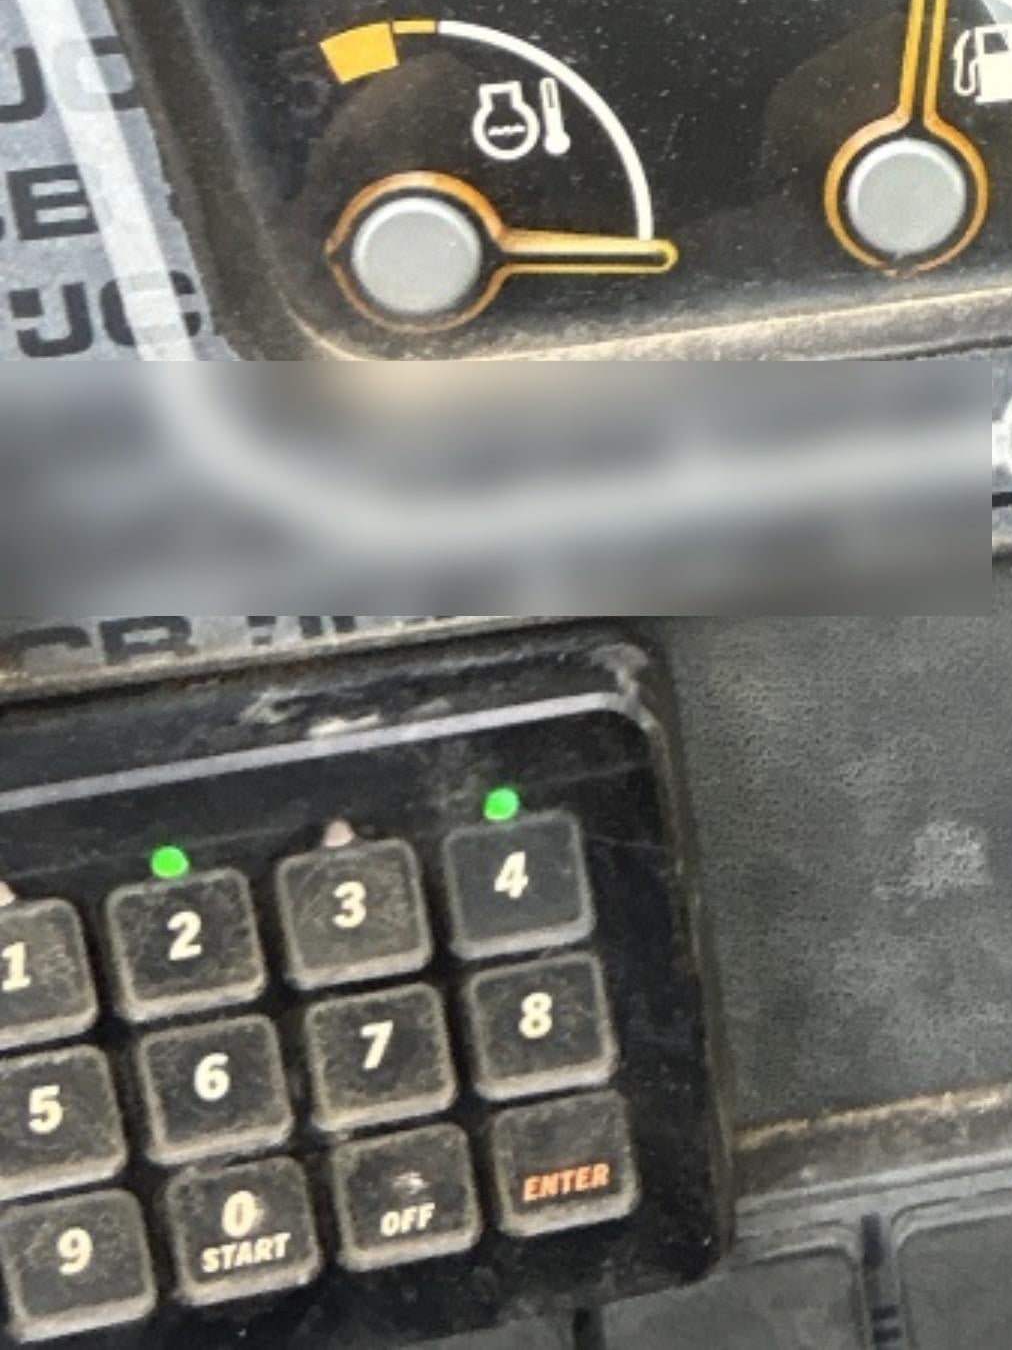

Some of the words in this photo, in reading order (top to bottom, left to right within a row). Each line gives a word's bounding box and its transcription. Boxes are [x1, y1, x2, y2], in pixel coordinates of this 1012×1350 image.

[494, 851, 530, 899] 4
[333, 881, 368, 928] 3
[166, 911, 203, 961] 2
[1, 942, 32, 991] 1
[518, 992, 554, 1039] 8
[360, 1020, 394, 1070] 7
[193, 1053, 230, 1102] 6
[28, 1085, 63, 1135] 5
[523, 1162, 611, 1202] ENTER
[381, 1202, 436, 1237] OFF
[56, 1227, 93, 1276] 9
[202, 1231, 291, 1274] START
